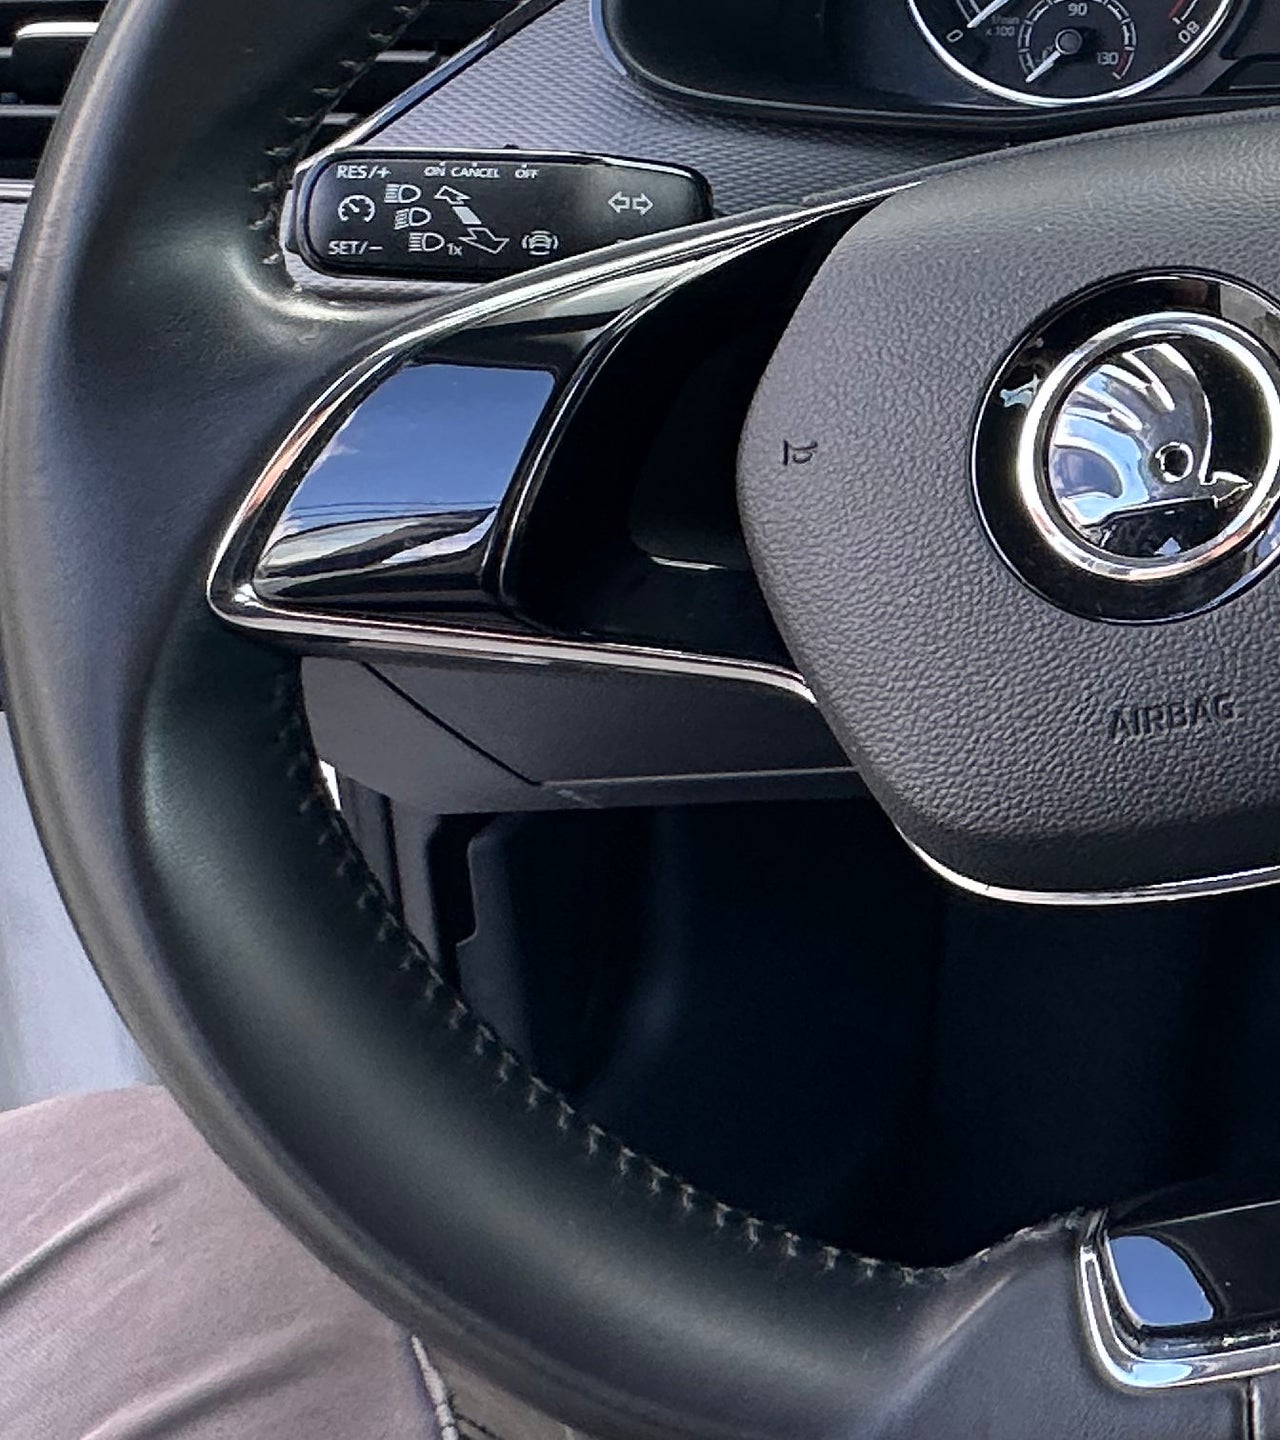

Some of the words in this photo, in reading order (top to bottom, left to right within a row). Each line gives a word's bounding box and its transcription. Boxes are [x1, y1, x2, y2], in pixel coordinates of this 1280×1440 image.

[1067, 2, 1088, 16] 90
[945, 28, 961, 44] 0
[1178, 21, 1200, 44] 80
[1096, 51, 1119, 65] 130
[336, 164, 392, 179] RES/+
[424, 166, 446, 178] ON
[451, 166, 500, 178] CANCEL
[514, 167, 540, 179] OFF
[1107, 691, 1237, 740] AIRBAG
